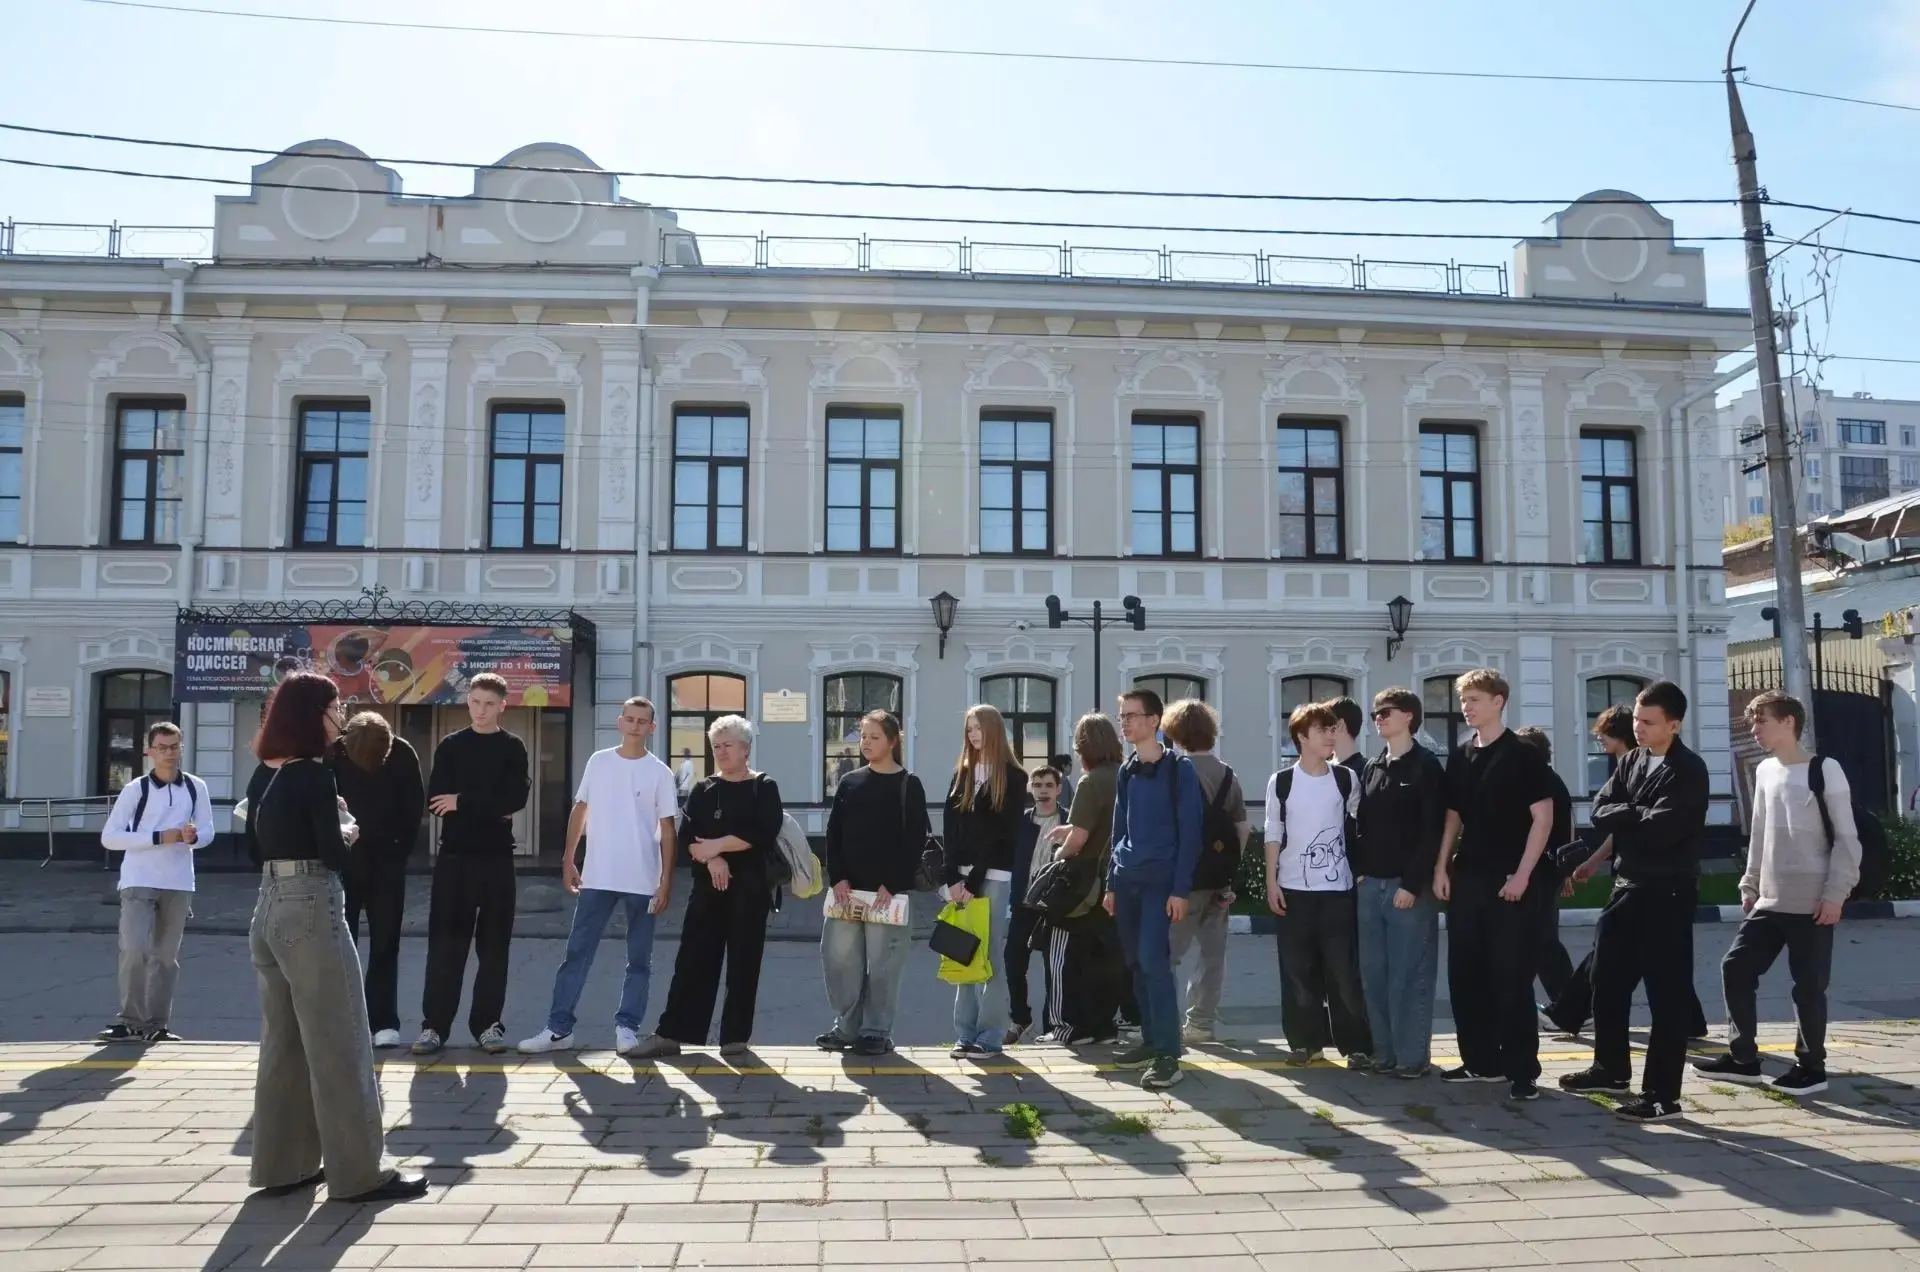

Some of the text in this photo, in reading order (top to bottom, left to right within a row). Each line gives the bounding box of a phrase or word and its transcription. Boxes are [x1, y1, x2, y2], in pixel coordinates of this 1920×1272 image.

[187, 636, 284, 652] КОСМИЧЕСКАЯ
[187, 655, 247, 672] ОДИССЕЯ
[525, 662, 560, 670] НОЯБРЯ
